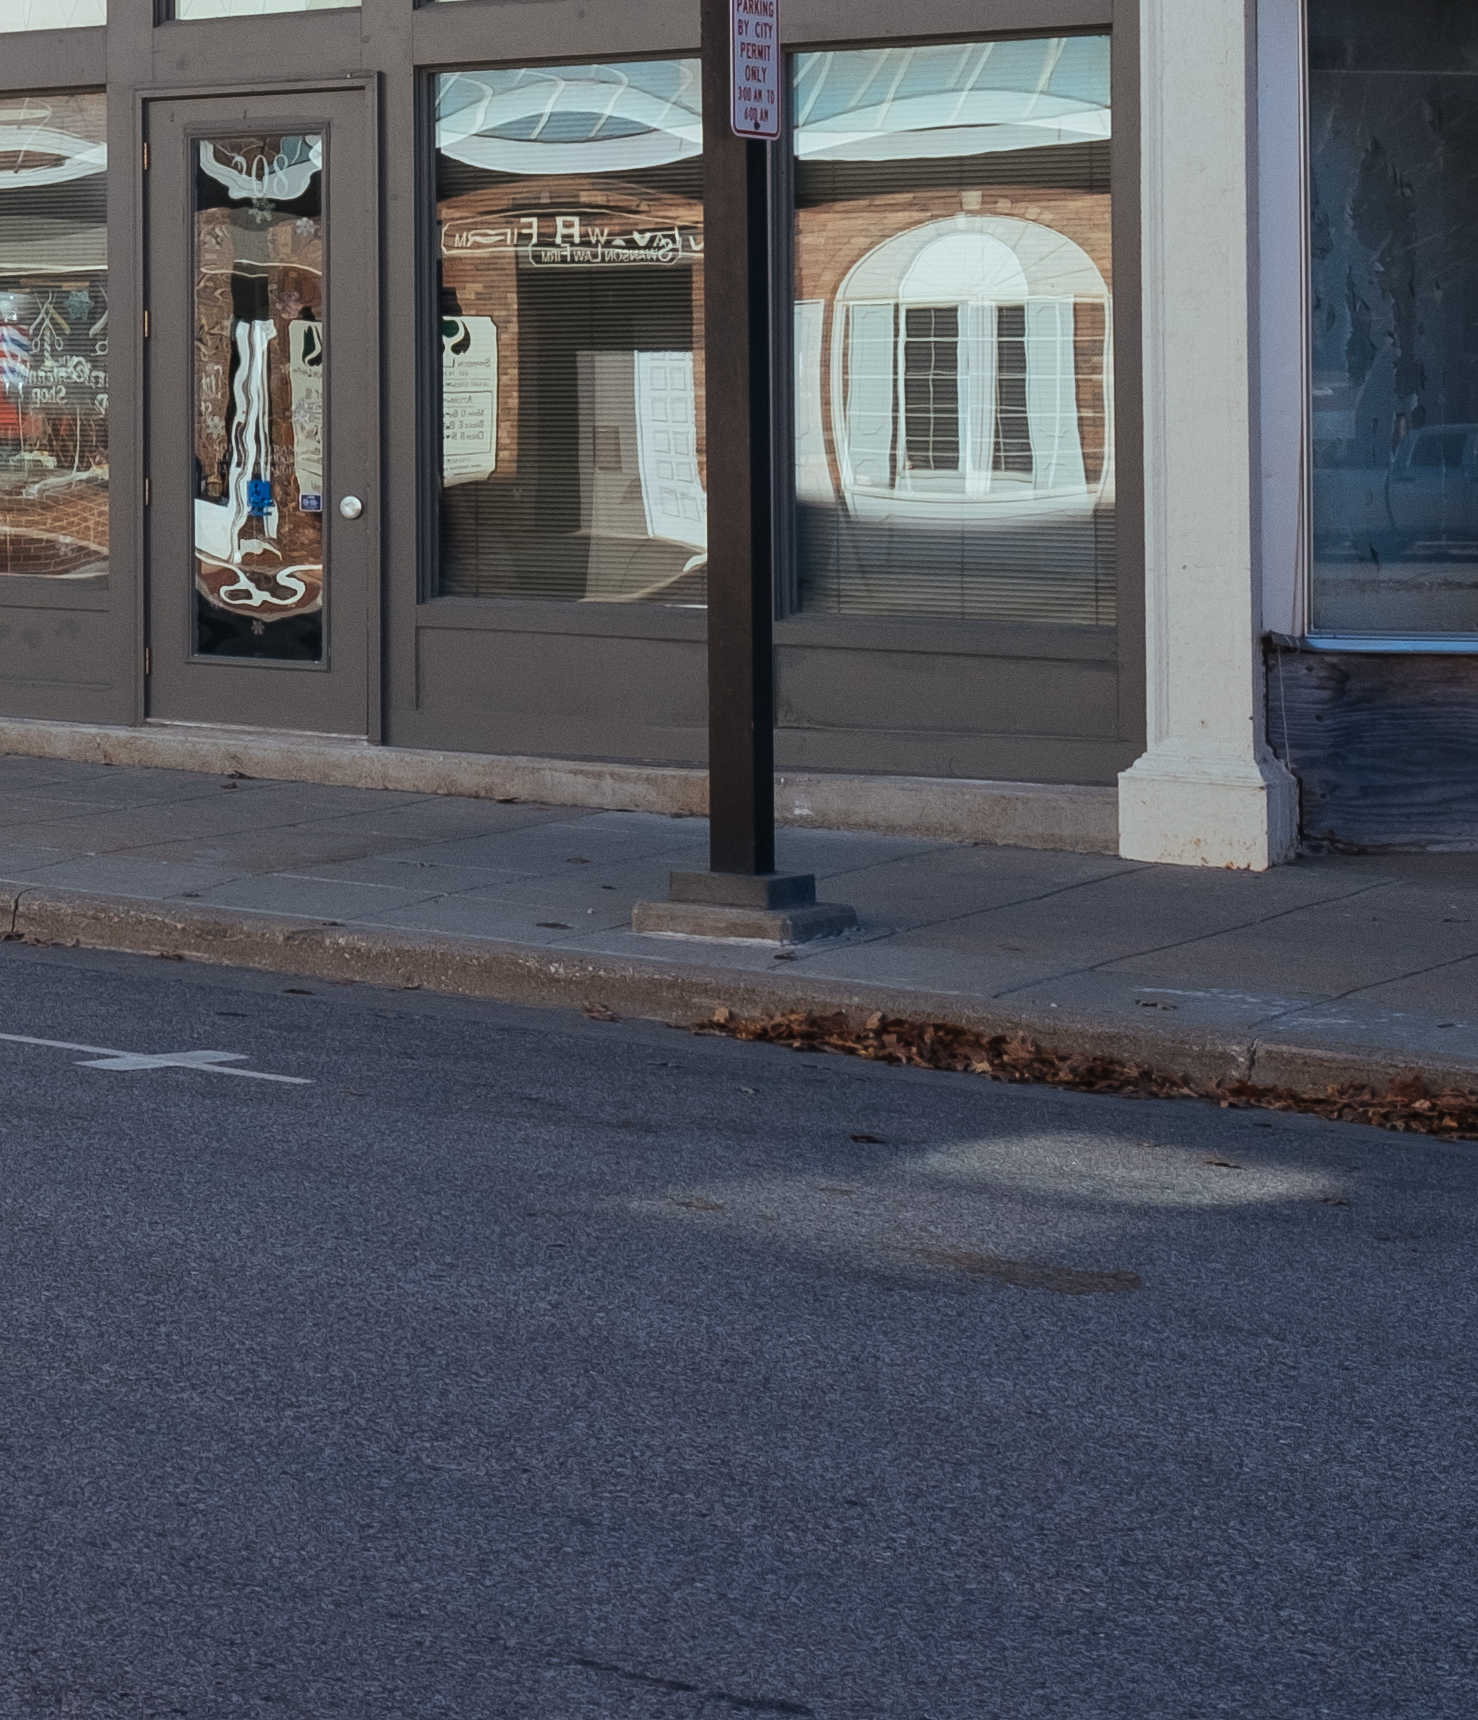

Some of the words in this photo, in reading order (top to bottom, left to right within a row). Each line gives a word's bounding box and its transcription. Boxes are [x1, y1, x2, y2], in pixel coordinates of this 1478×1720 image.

[737, 18, 750, 36] BY
[754, 22, 773, 40] CITY
[740, 41, 772, 63] PERMIT
[744, 64, 768, 84] ONLY
[754, 88, 763, 102] AM
[766, 89, 775, 105] TO
